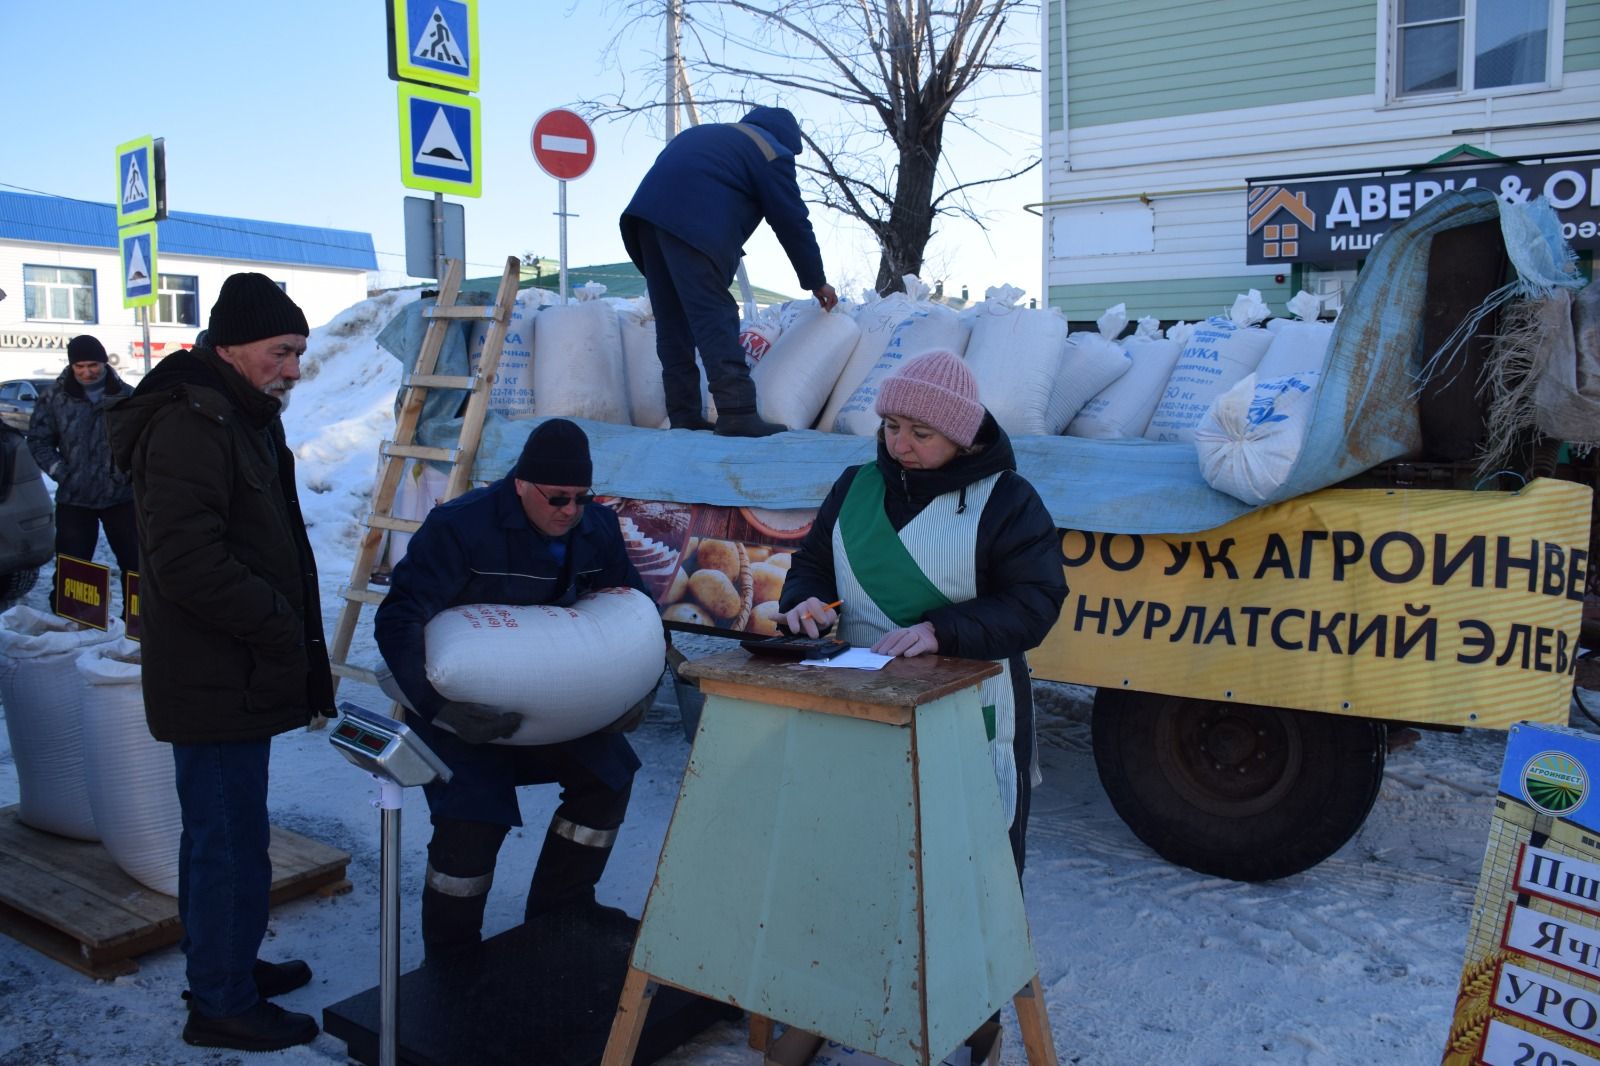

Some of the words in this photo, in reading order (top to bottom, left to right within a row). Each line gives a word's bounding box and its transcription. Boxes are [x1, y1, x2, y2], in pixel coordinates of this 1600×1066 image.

[1543, 169, 1600, 209] О
[1161, 538, 1239, 580] УК
[64, 578, 100, 607] ЯЧМЕНЬ
[1074, 594, 1438, 662] НУРЛАТСКИЙ
[1529, 767, 1582, 783] АГРОИНВЕСТ
[1530, 921, 1600, 969] Яч
[1505, 972, 1600, 1036] УРО
